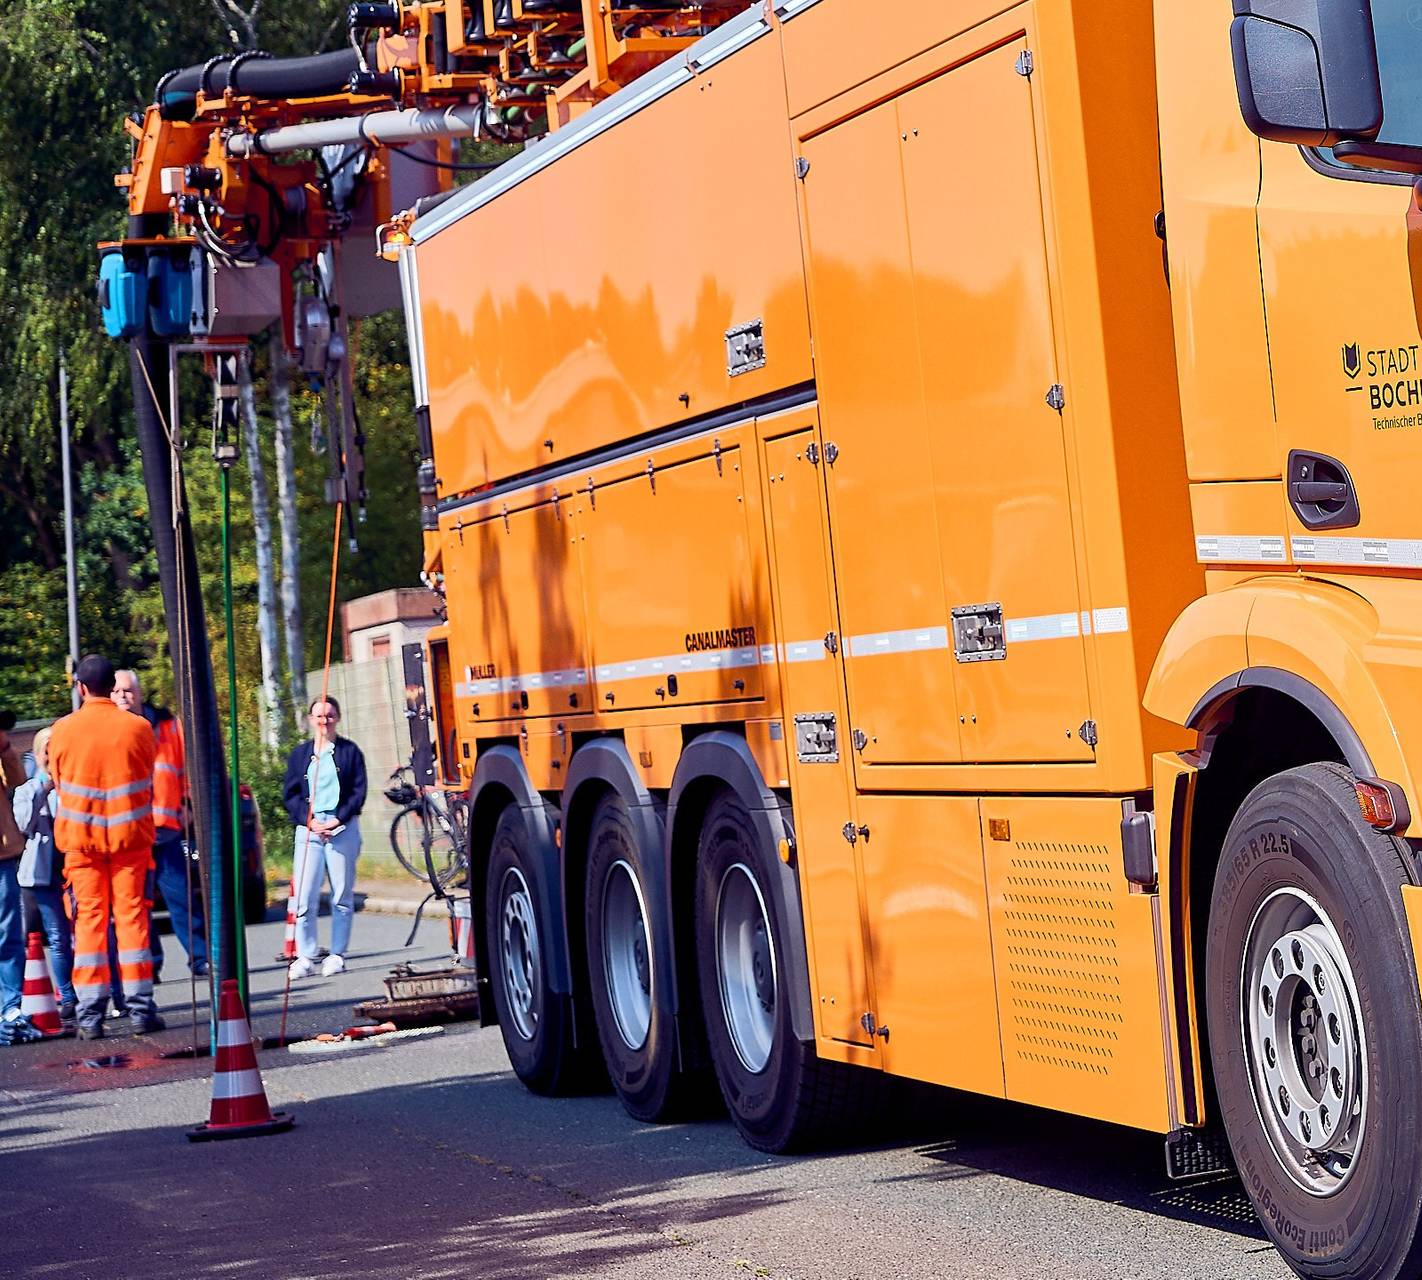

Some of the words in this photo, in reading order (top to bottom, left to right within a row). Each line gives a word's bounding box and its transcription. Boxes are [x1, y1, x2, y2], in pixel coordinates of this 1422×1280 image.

[1366, 345, 1419, 377] STADT
[1372, 415, 1417, 430] Technischer
[685, 626, 756, 652] CANALMASTER
[1249, 838, 1261, 859] R
[1260, 832, 1290, 854] 22.5
